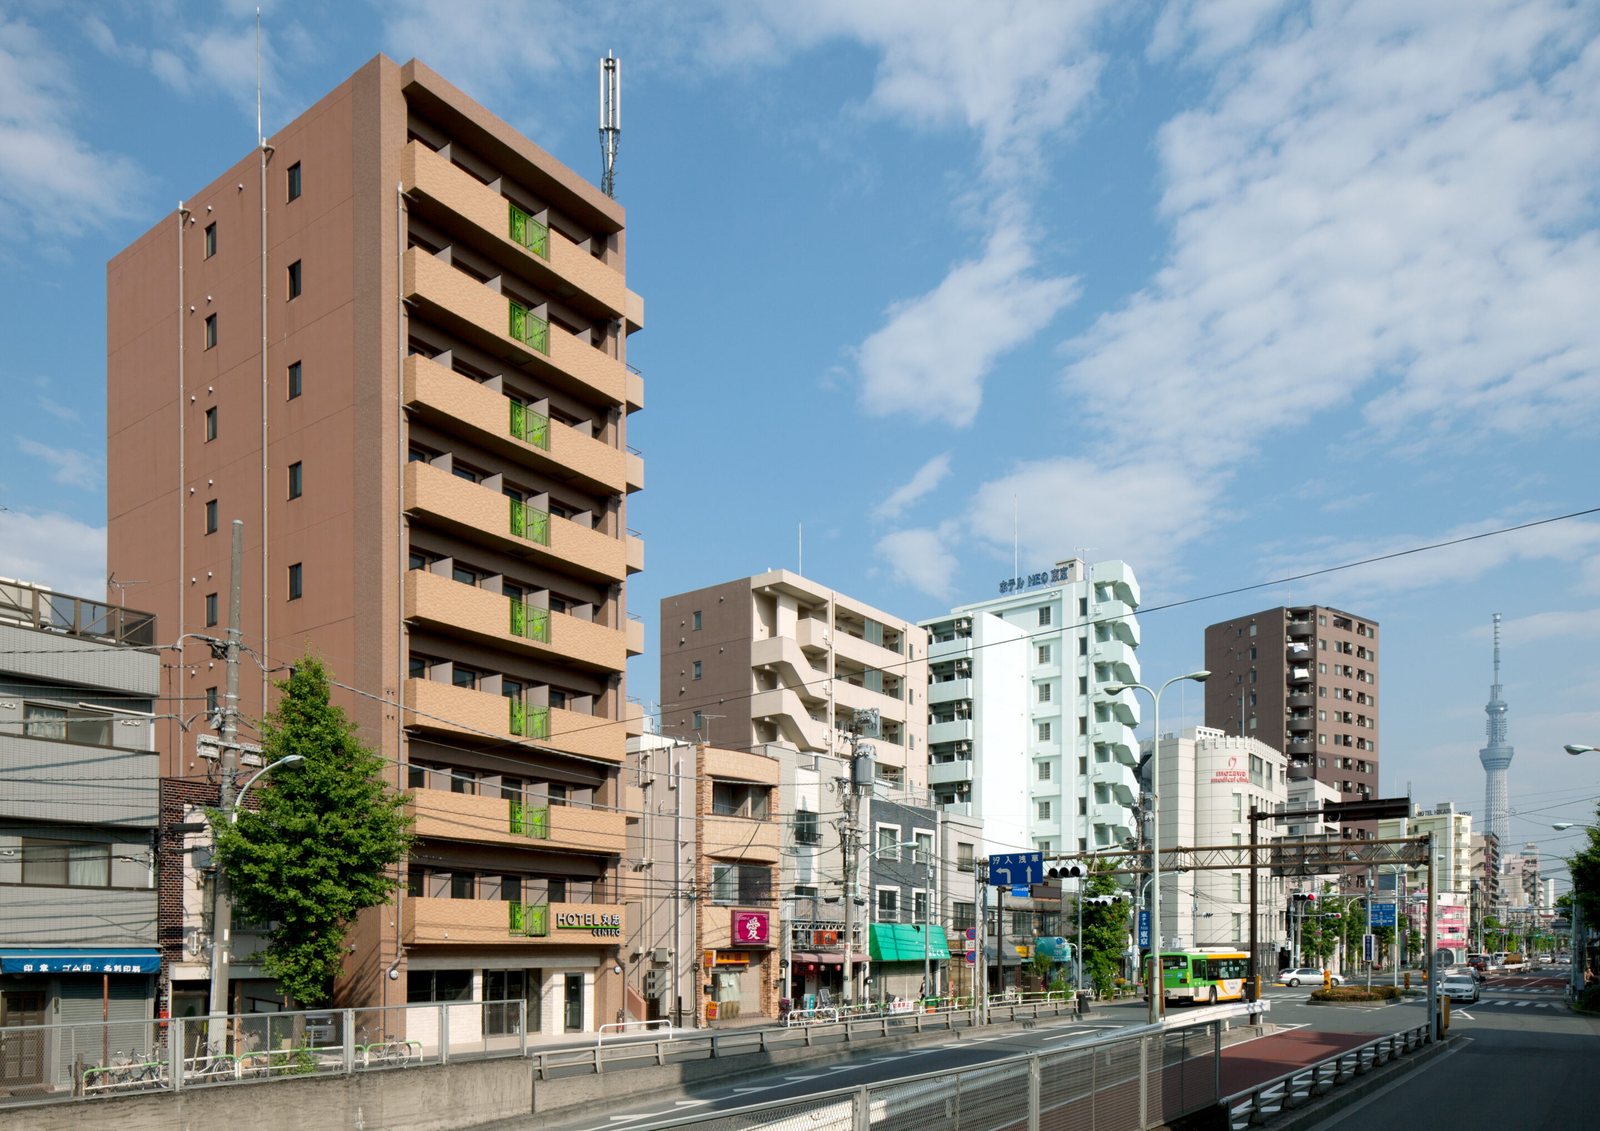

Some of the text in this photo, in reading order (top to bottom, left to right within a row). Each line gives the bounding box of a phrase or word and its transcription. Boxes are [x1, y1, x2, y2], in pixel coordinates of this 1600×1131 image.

[1028, 572, 1049, 587] NEO
[992, 855, 1013, 865] 汐入
[1018, 854, 1040, 864] 浅草
[556, 913, 599, 926] HOTEL
[592, 928, 621, 937] CENTRO
[746, 916, 761, 940] 愛
